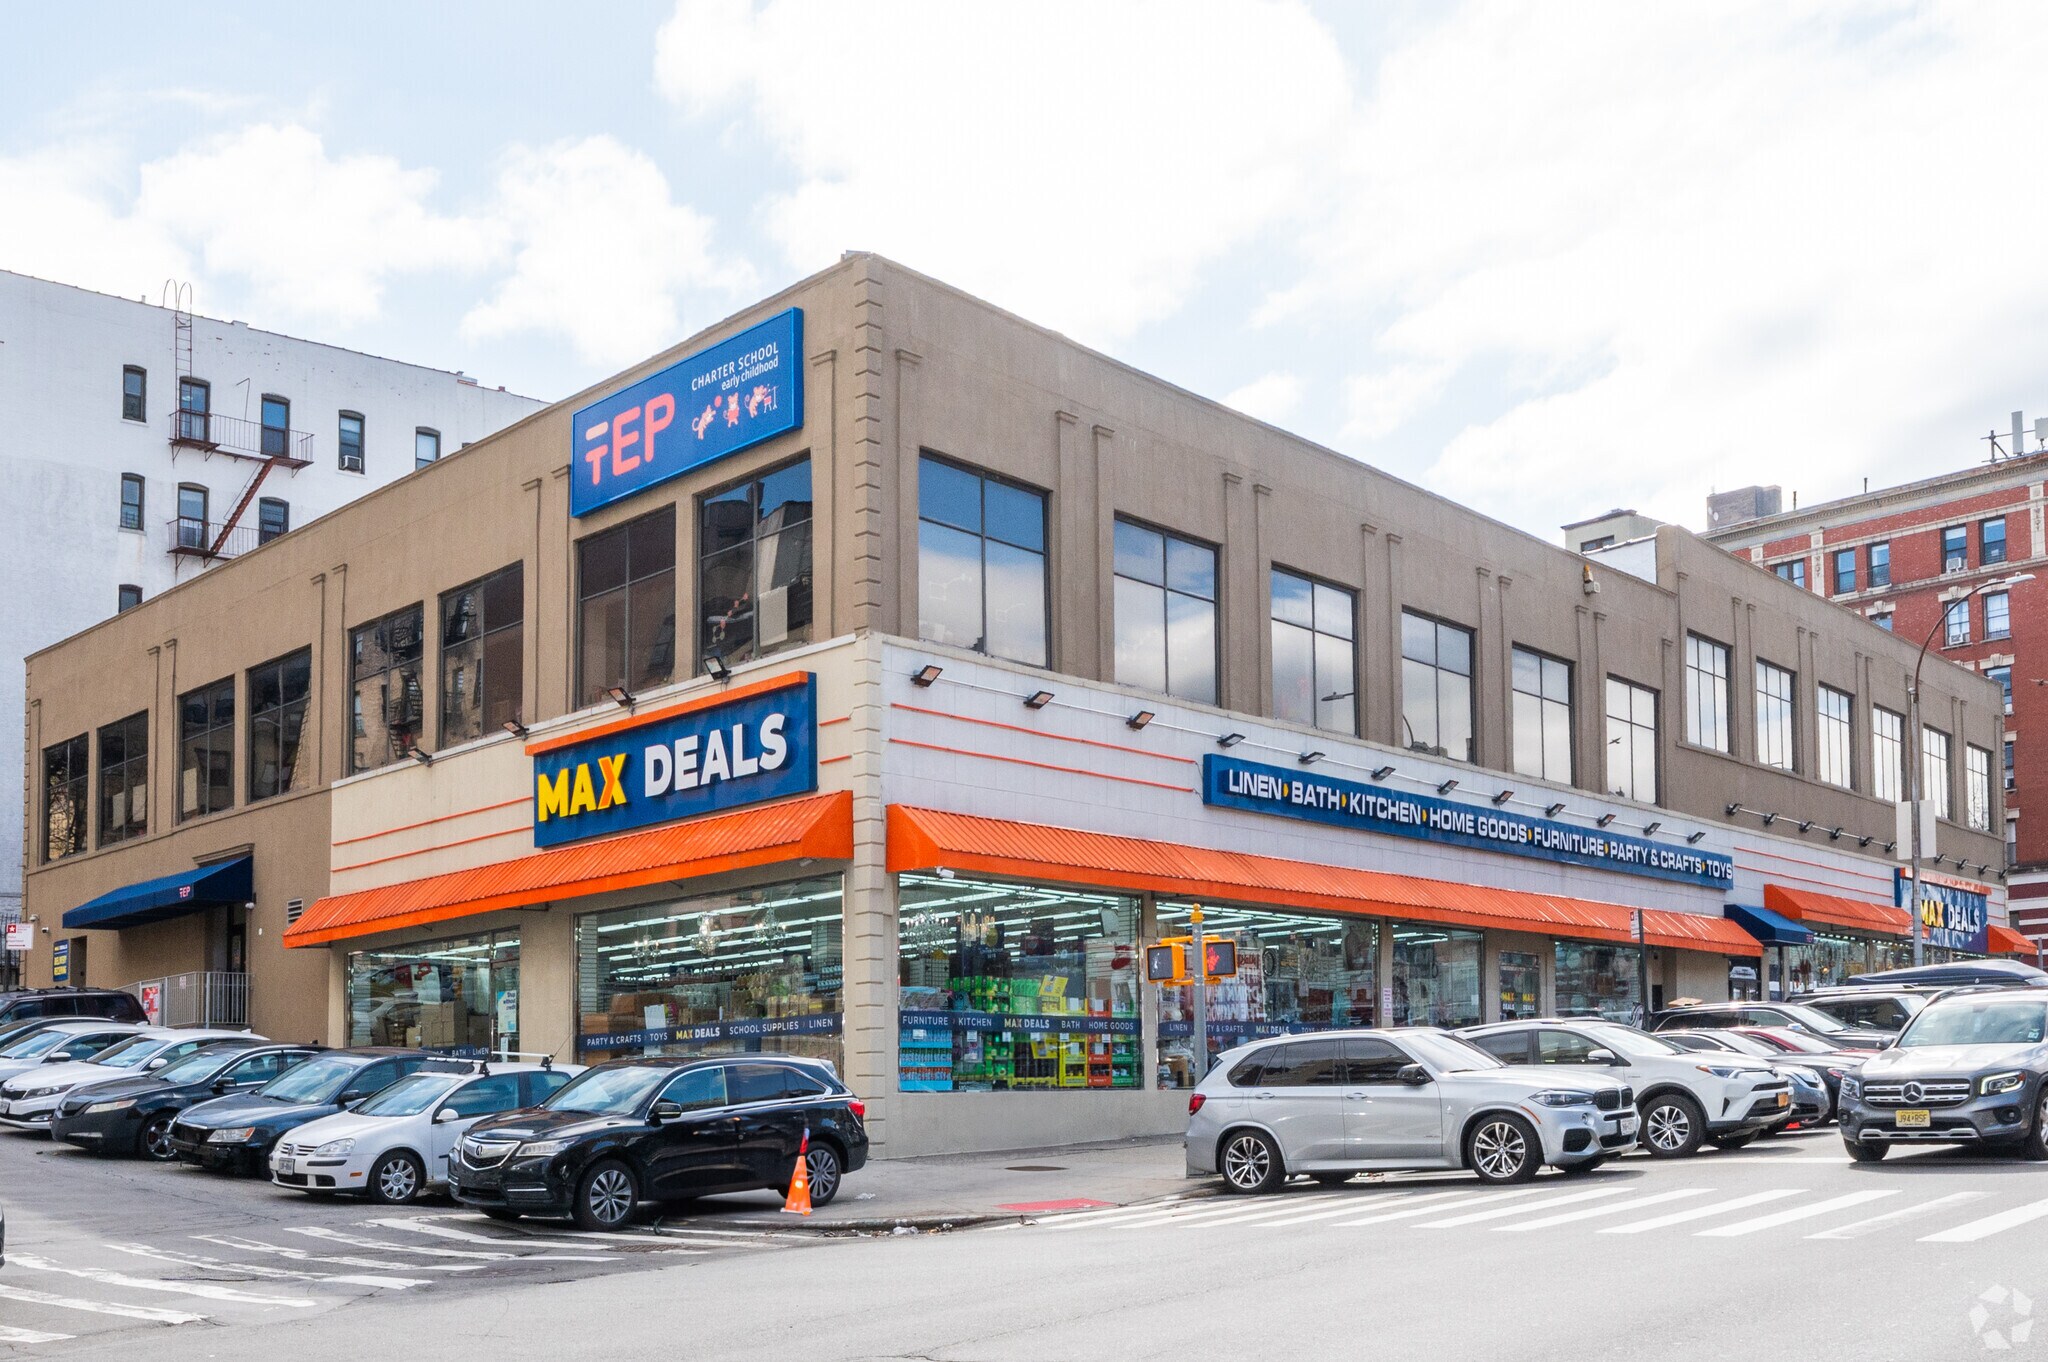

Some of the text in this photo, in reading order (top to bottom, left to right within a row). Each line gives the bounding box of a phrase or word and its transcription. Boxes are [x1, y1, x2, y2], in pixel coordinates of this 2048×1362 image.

[691, 341, 779, 391] CHARTER SCHOOL
[721, 356, 779, 391] early childhood
[537, 713, 788, 822] MAX DEALS
[1228, 768, 1733, 880] LINEN BATH KITCHEN HOME GOODS FURNITURE PARTY & CRAFTS TOYS
[1948, 903, 1980, 933] DEALS
[587, 1018, 833, 1046] PARTY & CRAFTS TOYS MAX DEALS SCHOOL SUPPLIES LINEN
[902, 1015, 1134, 1031] FURNITURE KITCHEN MAX DEALS BATH HOME GOODS
[1221, 1025, 1244, 1033] CRAFTS
[1256, 1025, 1269, 1034] MAX
[1270, 1026, 1290, 1034] DEALS
[451, 1049, 467, 1057] BATH
[472, 1047, 489, 1056] LINEN
